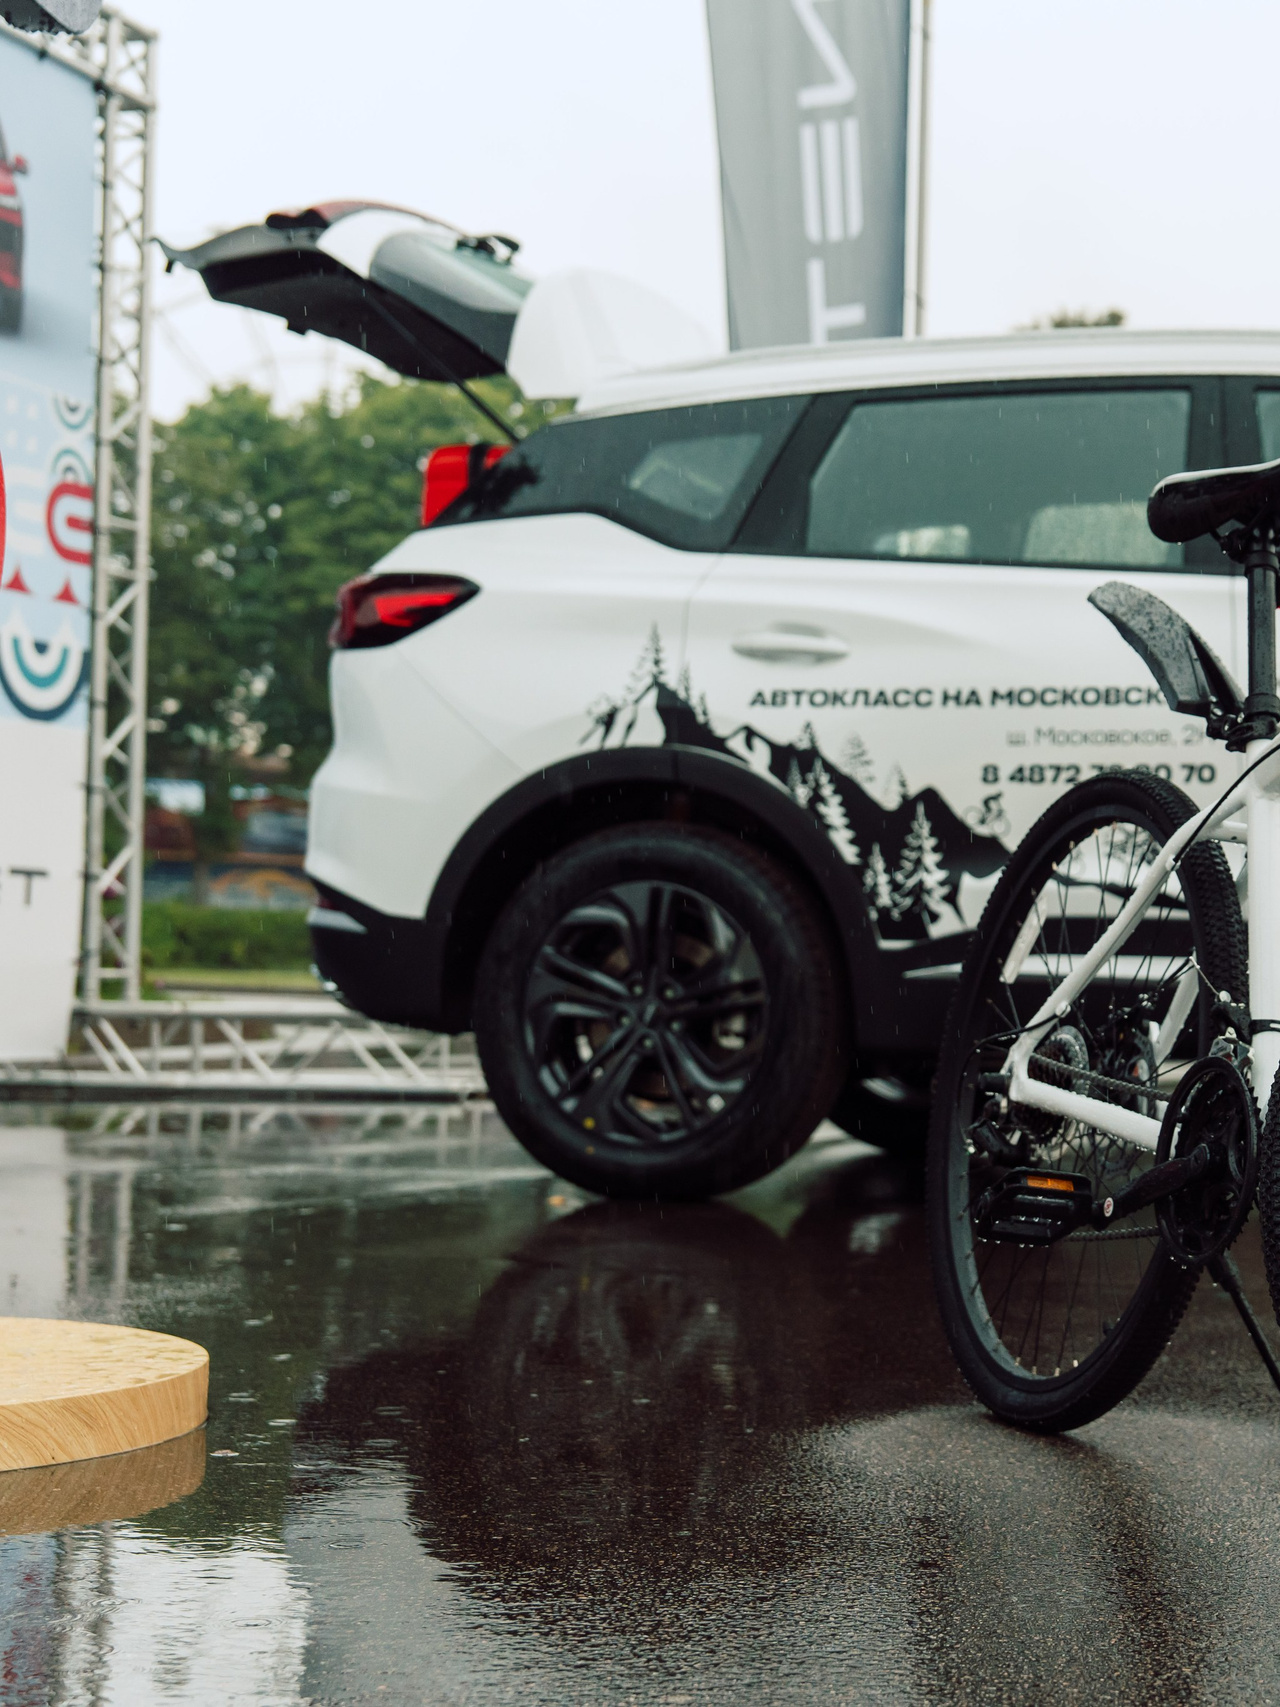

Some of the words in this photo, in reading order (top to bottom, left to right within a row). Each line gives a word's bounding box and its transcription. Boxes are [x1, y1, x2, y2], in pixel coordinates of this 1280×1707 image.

[749, 688, 933, 708] АВТОКЛАСС
[943, 687, 983, 707] НА
[991, 686, 1165, 707] МОСКОВСК
[981, 764, 1000, 785] 8
[1008, 764, 1081, 785] 4872
[1181, 764, 1216, 784] 70
